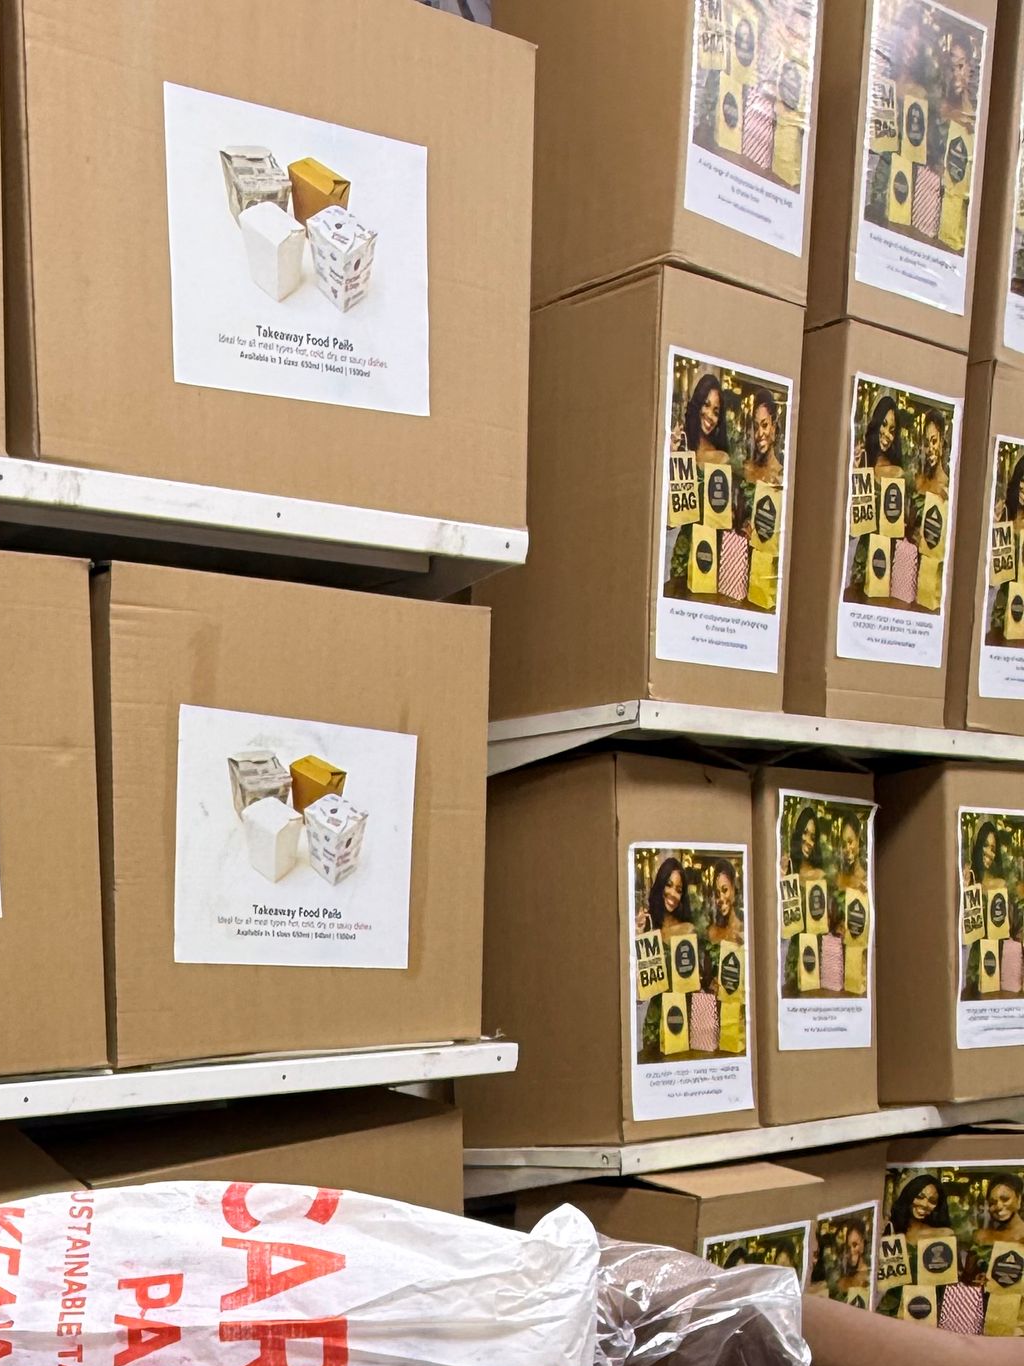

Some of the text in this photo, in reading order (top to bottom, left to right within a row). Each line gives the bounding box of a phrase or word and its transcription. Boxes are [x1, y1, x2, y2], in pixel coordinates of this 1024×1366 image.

[256, 324, 354, 352] Takeaway Food Pails
[672, 492, 697, 513] BAG
[852, 504, 874, 524] BAG
[992, 554, 1014, 574] BAG
[252, 904, 296, 920] Takeaway
[298, 907, 320, 918] Food
[640, 965, 665, 988] BAG
[56, 1191, 94, 1336] USTAINABLE
